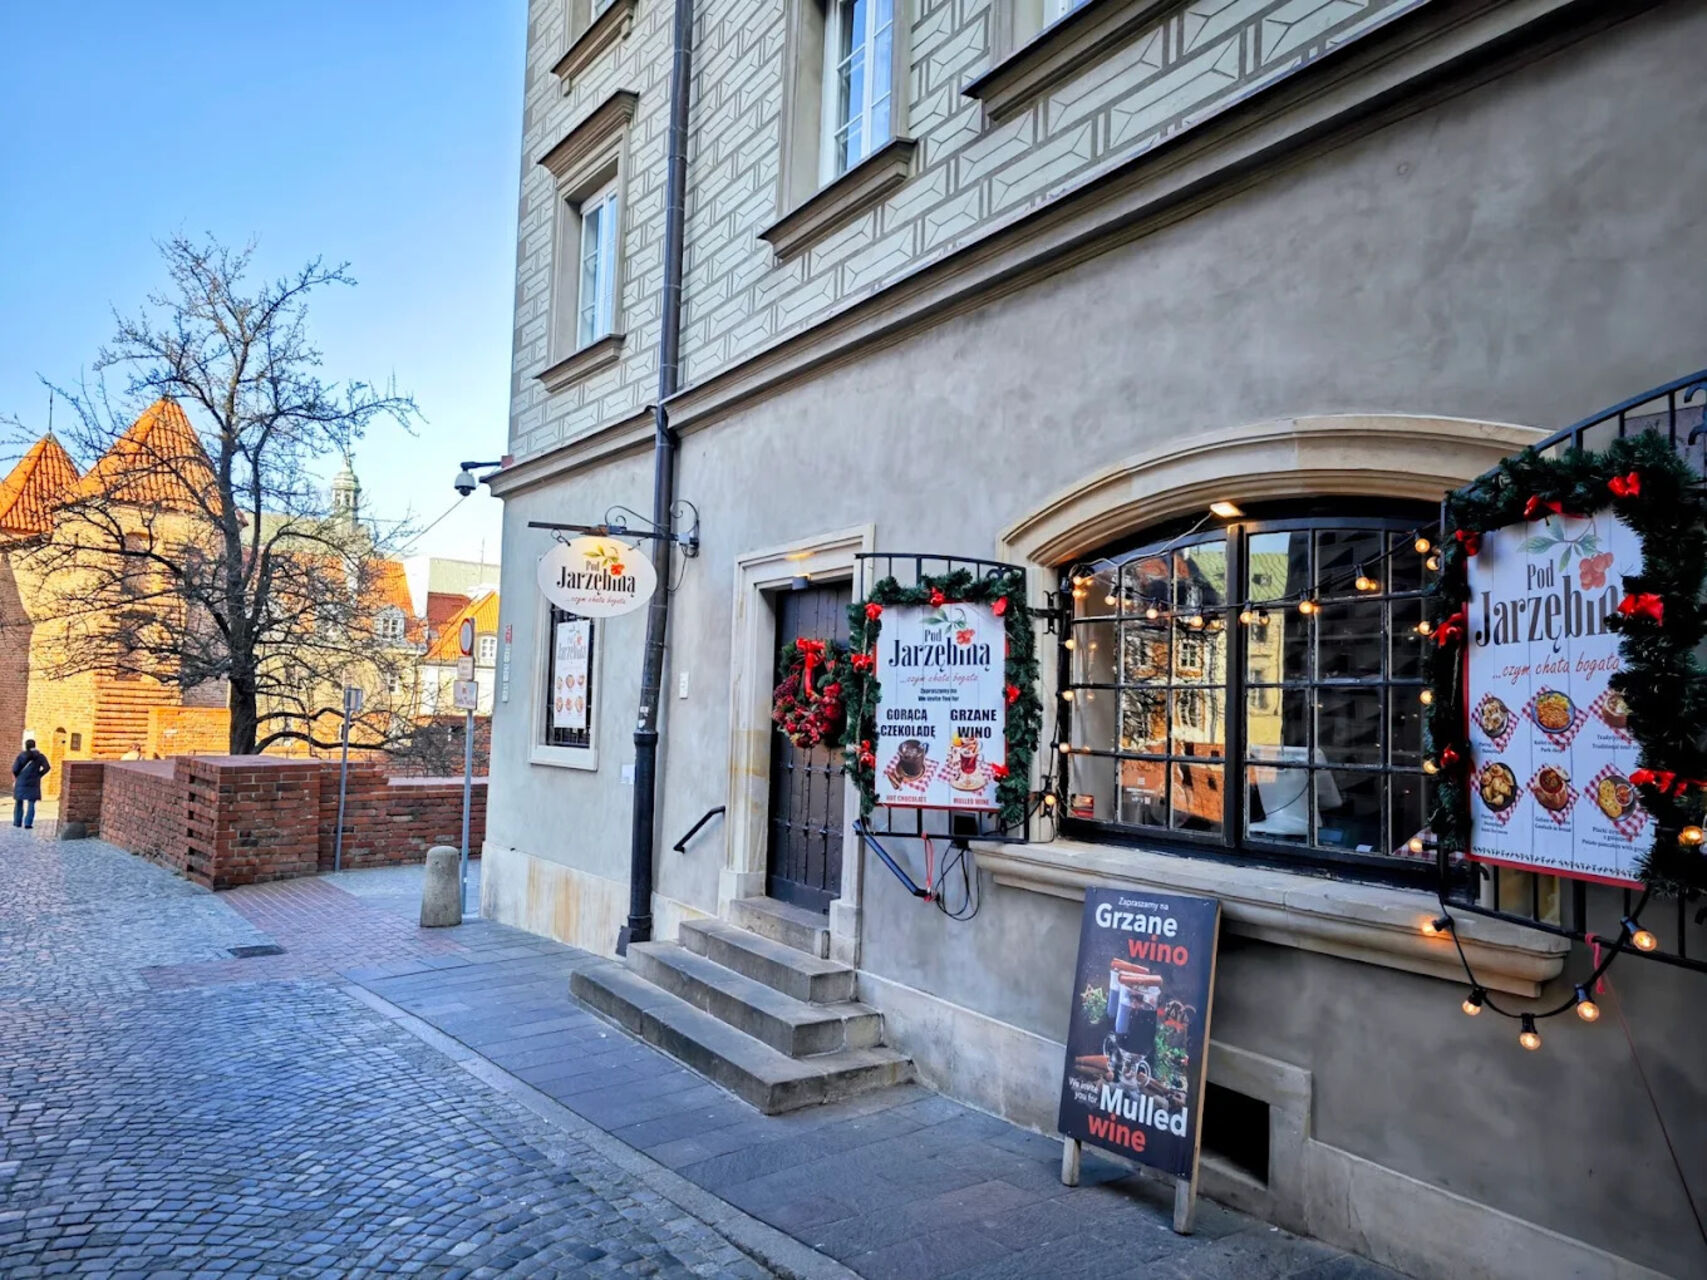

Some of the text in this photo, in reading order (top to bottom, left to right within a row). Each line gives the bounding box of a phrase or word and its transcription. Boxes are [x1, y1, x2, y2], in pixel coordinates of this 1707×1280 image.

[556, 566, 635, 598] Jarzębiną
[1527, 559, 1555, 590] Pod
[1476, 575, 1620, 654] Jarzębin
[925, 629, 942, 642] Pod
[888, 637, 991, 672] Jarzębiną
[1535, 654, 1570, 674] chata
[1575, 651, 1620, 681] bogata
[886, 708, 928, 722] GORĄCĄ
[950, 709, 997, 721] GRZANE
[880, 725, 936, 739] CZEKOLADĘ
[958, 726, 992, 739] WINO
[1118, 896, 1169, 911] Zapraszamy na
[1095, 903, 1178, 937] Grzane
[1128, 935, 1189, 966] wino
[1100, 1084, 1188, 1138] Mulled
[1088, 1113, 1147, 1153] wine
